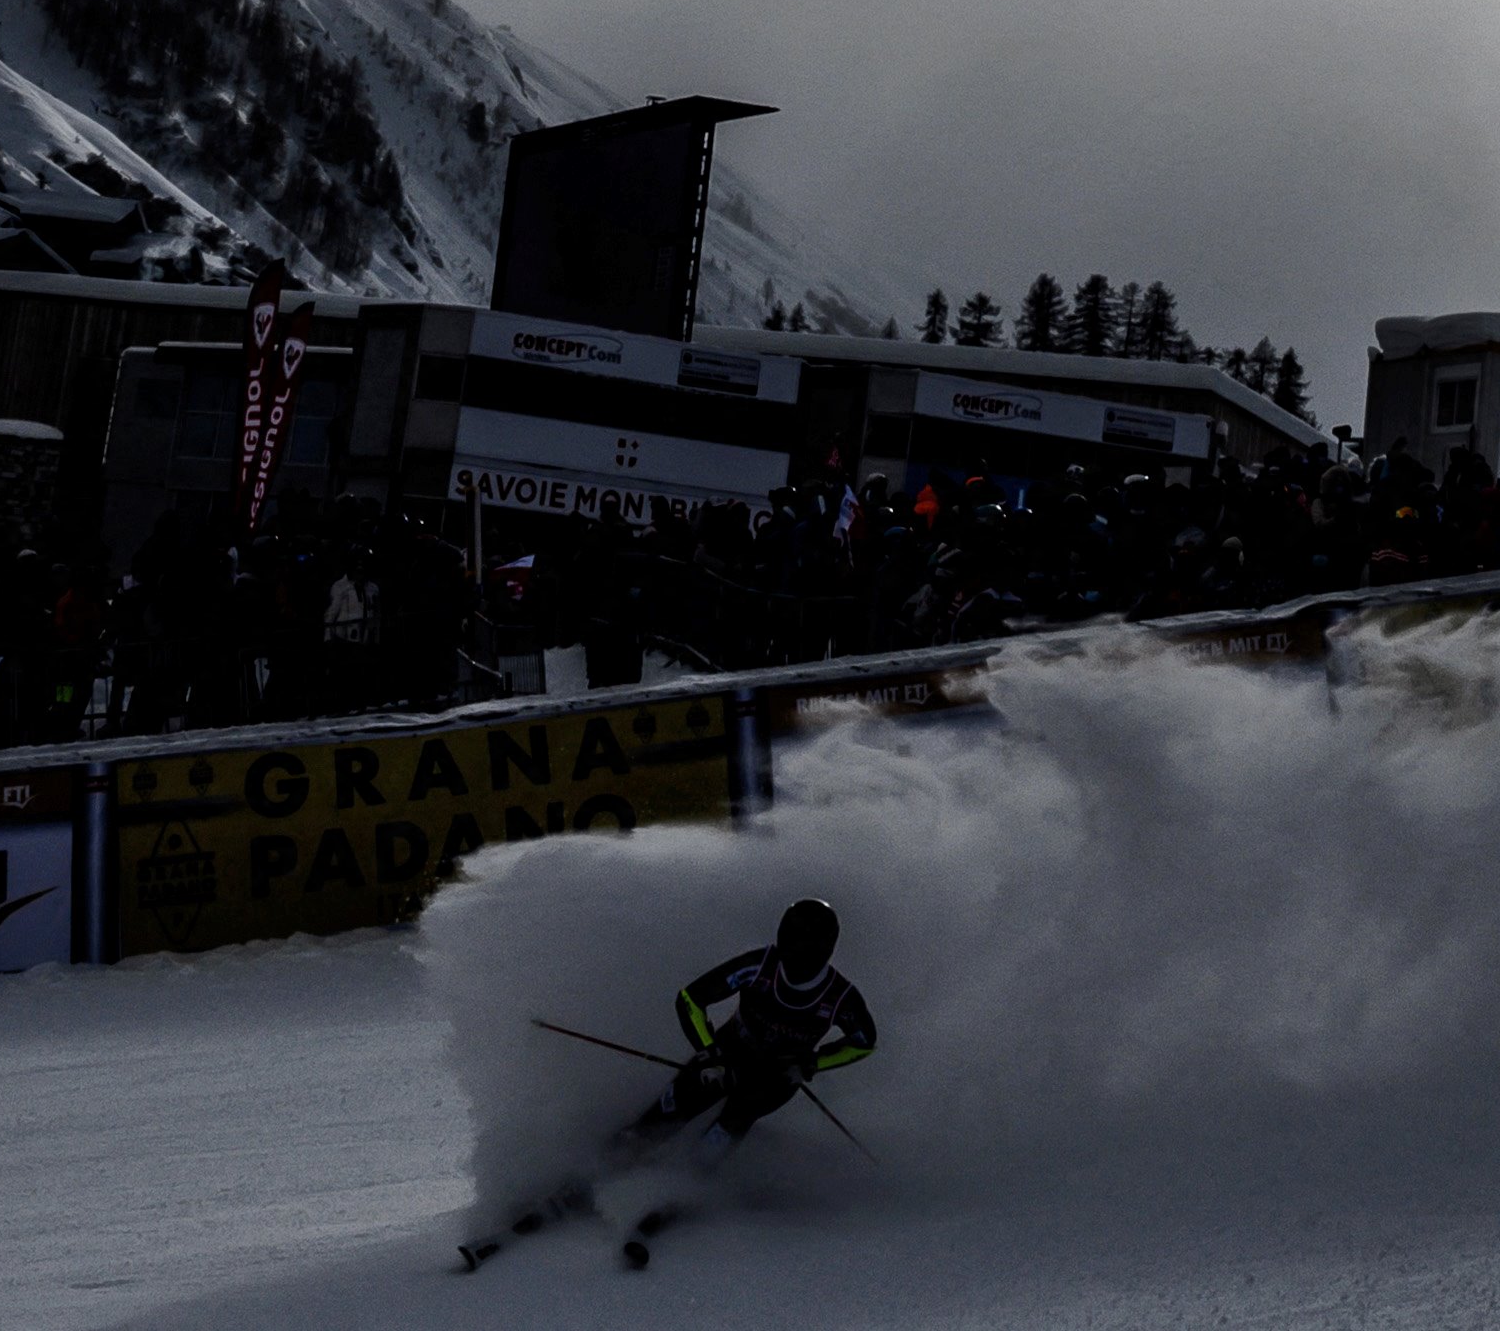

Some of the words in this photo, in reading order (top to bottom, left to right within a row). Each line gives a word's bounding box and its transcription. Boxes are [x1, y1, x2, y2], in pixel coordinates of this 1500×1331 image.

[513, 333, 585, 358] CONCEPT
[953, 392, 1012, 415] CONCEPT
[249, 386, 291, 529] SSIGNOL
[455, 470, 568, 509] SAVOIE
[671, 499, 773, 534] BLC
[1228, 635, 1262, 654] MIT
[864, 686, 901, 705] MIT
[904, 683, 928, 701] FTI
[244, 717, 631, 818] GRANA
[3, 784, 31, 805] FTI
